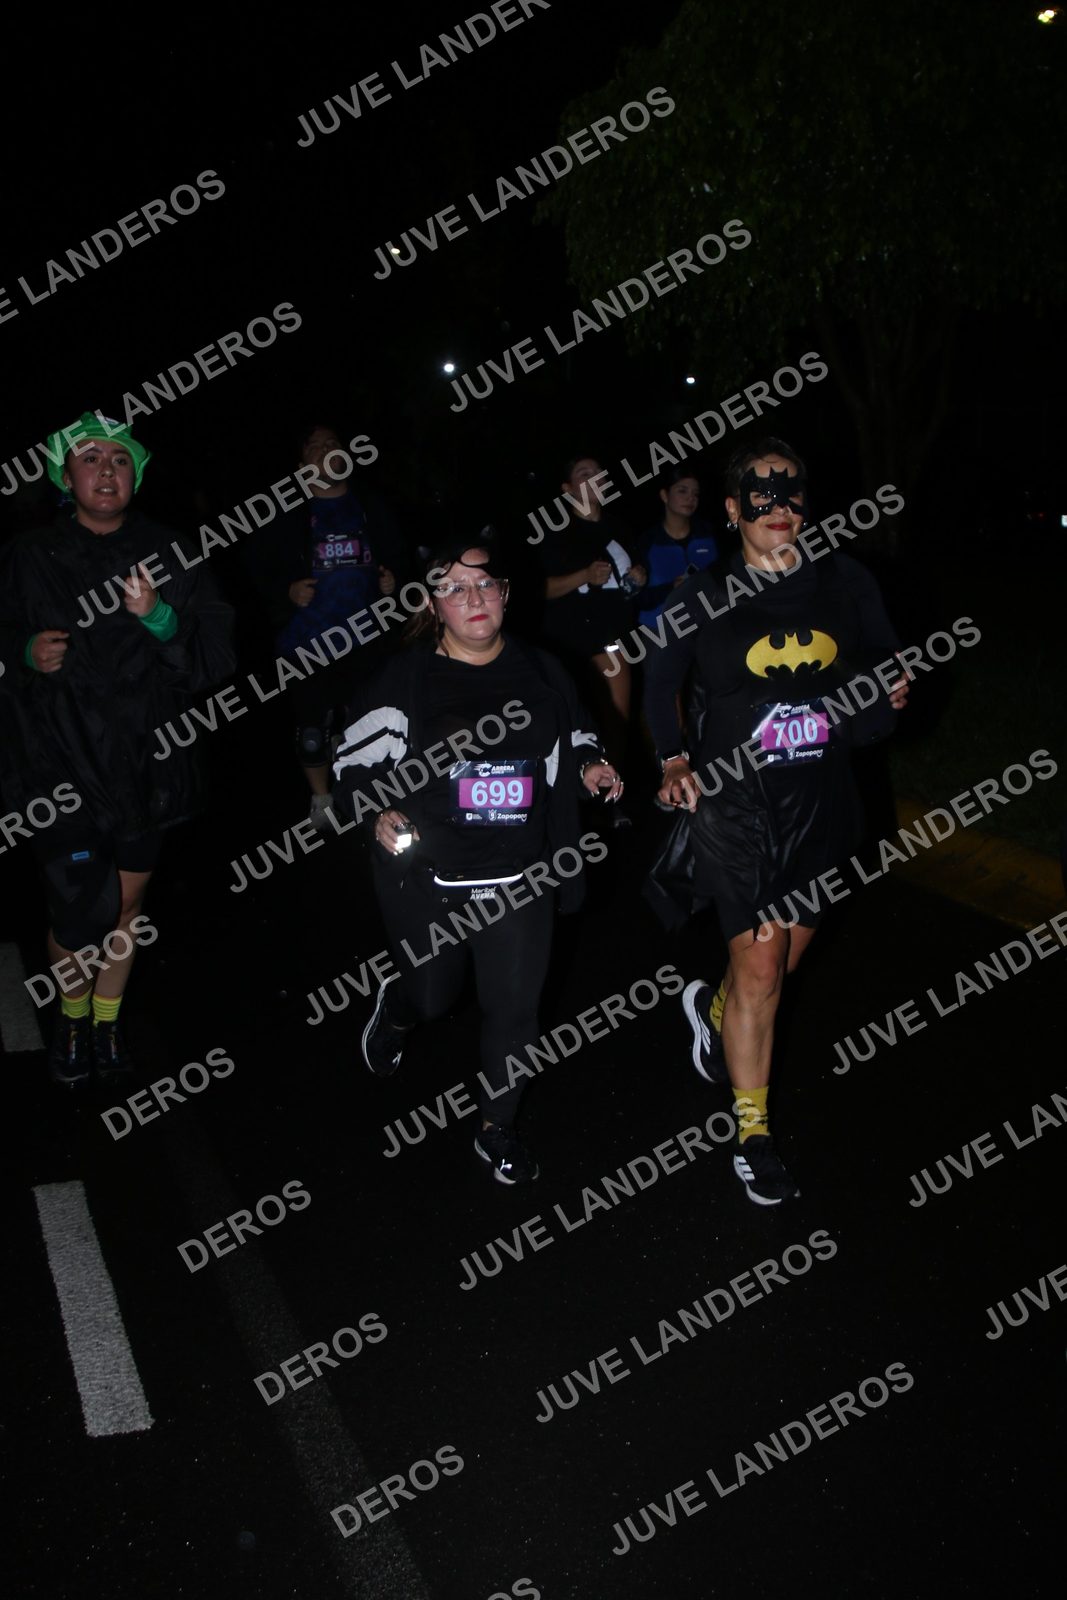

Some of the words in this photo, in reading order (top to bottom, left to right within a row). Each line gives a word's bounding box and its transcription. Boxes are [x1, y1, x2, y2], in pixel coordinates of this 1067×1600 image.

[325, 542, 354, 557] 884
[773, 718, 818, 747] 700
[471, 780, 524, 806] 699
